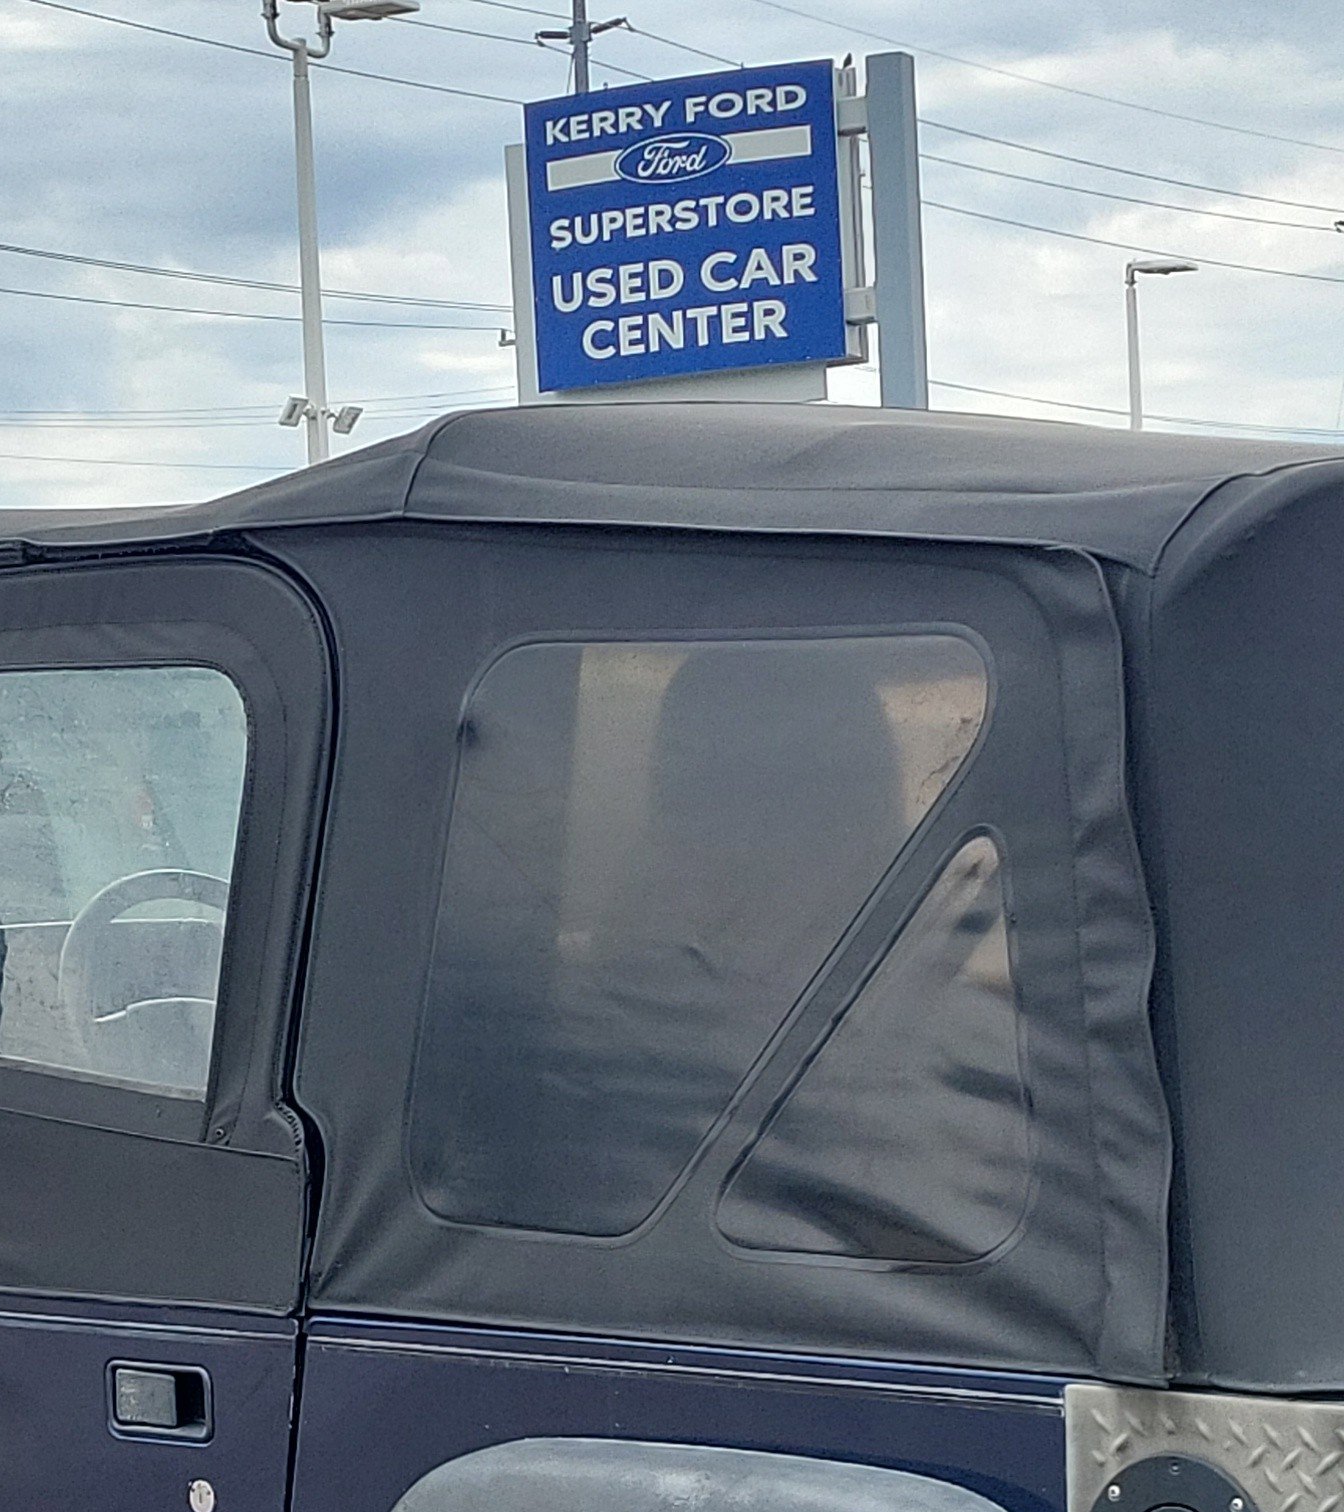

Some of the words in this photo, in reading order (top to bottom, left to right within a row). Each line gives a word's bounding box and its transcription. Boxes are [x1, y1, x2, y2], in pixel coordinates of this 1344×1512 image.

[544, 99, 671, 146] KERRY
[684, 83, 808, 123] FORD
[637, 139, 709, 178] Ford
[549, 184, 816, 250] SUPERSTORE
[551, 258, 685, 313] USED
[700, 242, 818, 292] CAR
[581, 299, 788, 360] CENTER
